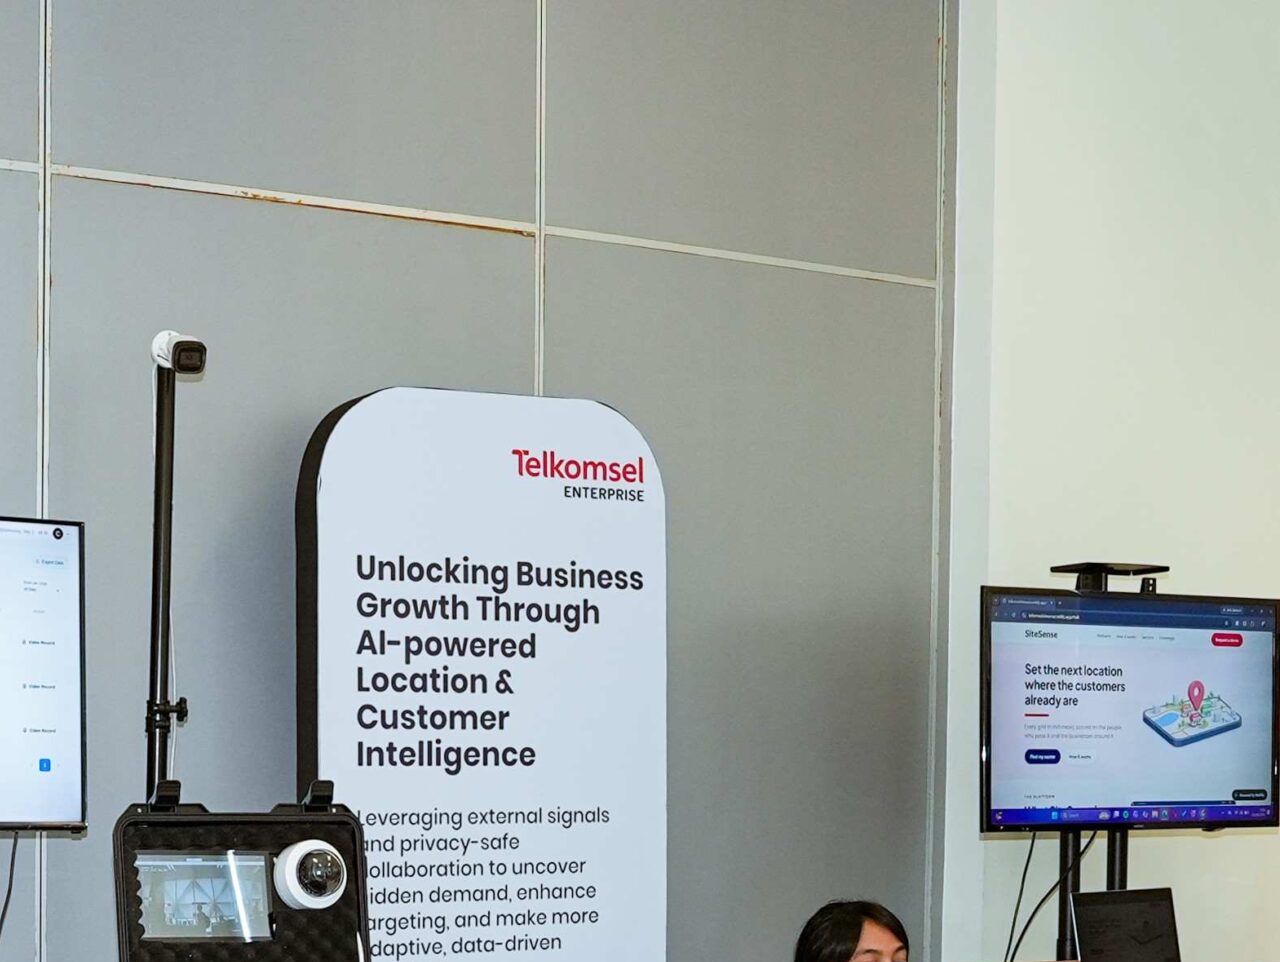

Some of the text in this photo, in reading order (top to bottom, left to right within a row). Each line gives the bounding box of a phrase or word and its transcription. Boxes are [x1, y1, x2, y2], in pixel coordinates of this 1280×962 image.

[511, 448, 644, 484] Telkomsel
[563, 485, 645, 502] ENTERPRISE
[356, 554, 644, 595] Unlocking Business
[356, 591, 600, 633] Growth Through
[1024, 629, 1058, 639] SiteSense
[356, 629, 536, 667] AI-powered
[357, 665, 515, 695] Location &
[1024, 662, 1123, 677] Set the next location
[1024, 679, 1126, 693] where the customers
[1024, 694, 1079, 709] already are
[356, 703, 510, 731] Customer
[357, 738, 536, 776] Intelligence
[356, 806, 610, 830] Leveraging external signals
[400, 832, 520, 858] privacy-safe
[366, 860, 587, 880] ollaboration to uncover
[369, 883, 597, 905] idden demand, enhance
[367, 909, 599, 935] argeting, and make more
[370, 934, 562, 962] daptive, data-driven
